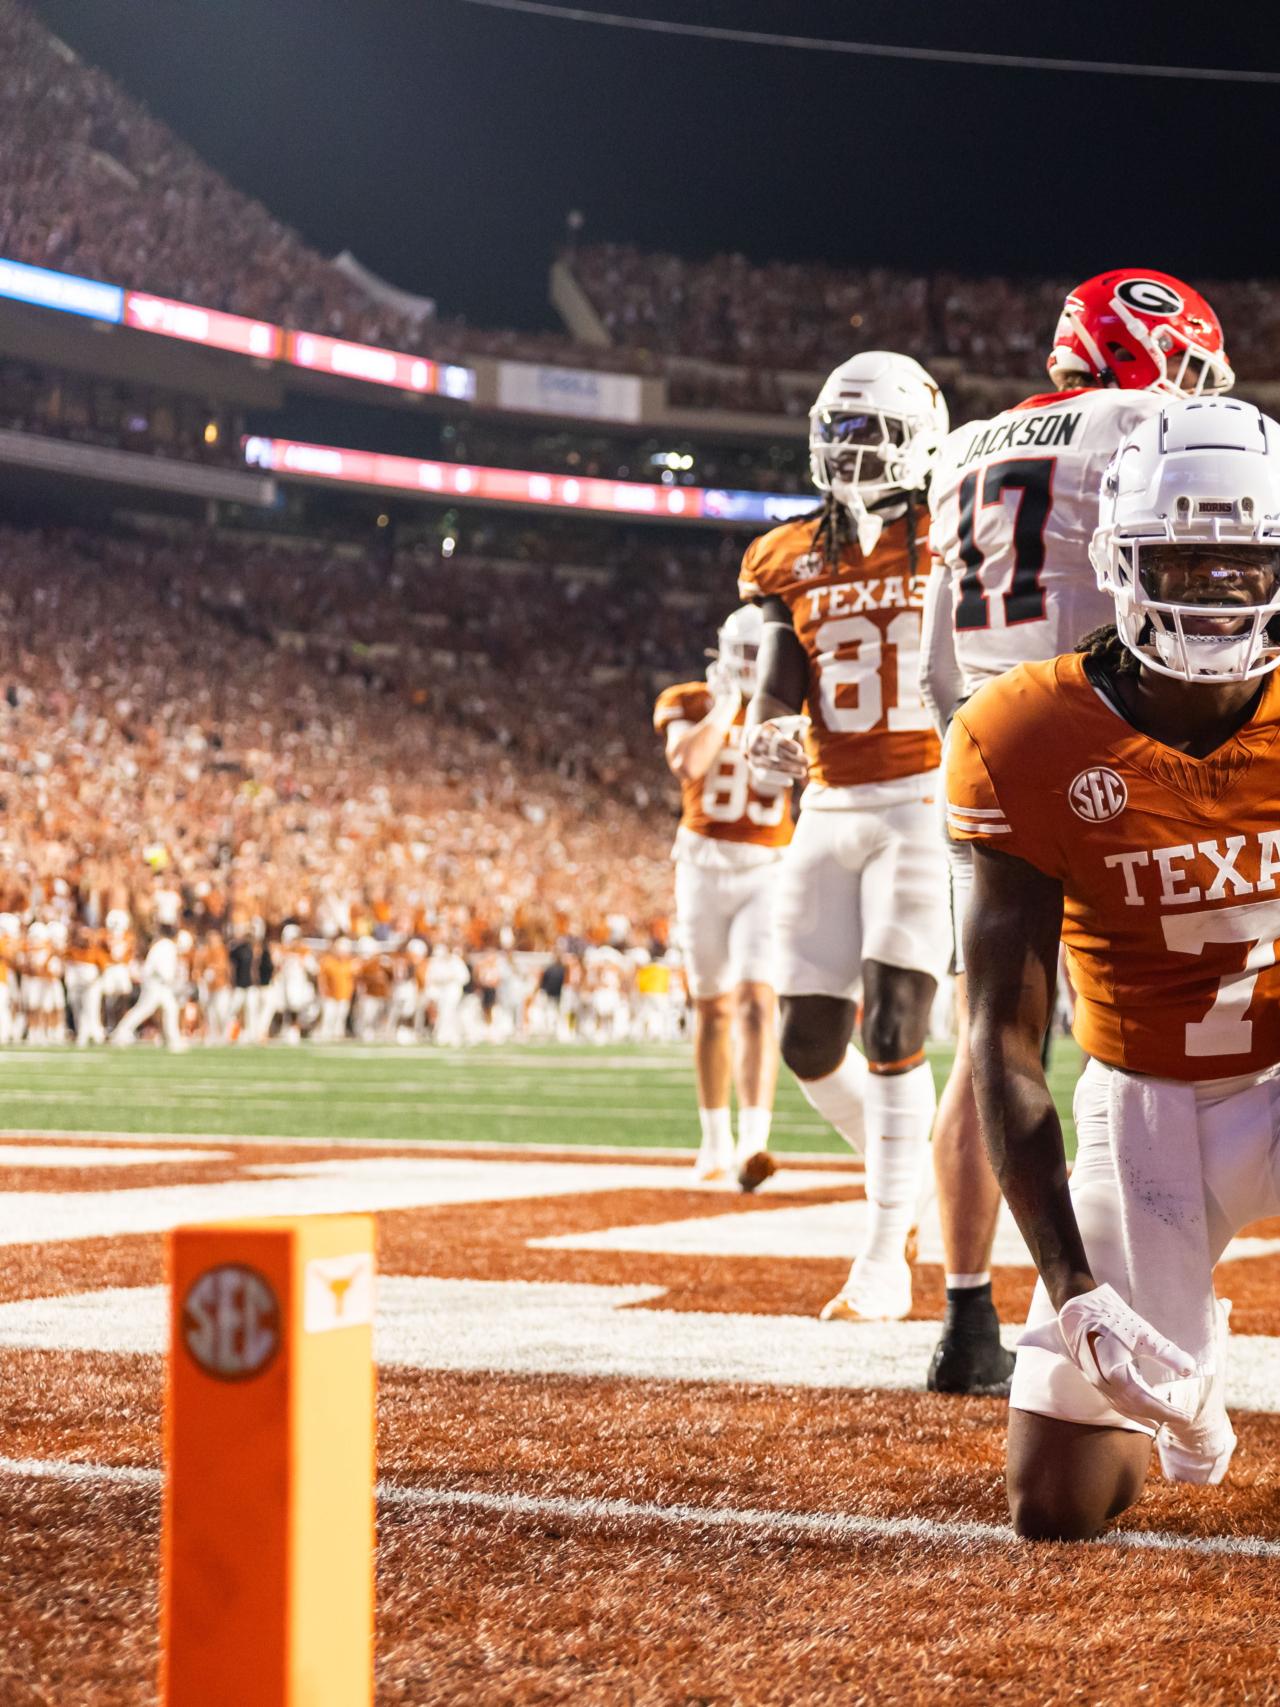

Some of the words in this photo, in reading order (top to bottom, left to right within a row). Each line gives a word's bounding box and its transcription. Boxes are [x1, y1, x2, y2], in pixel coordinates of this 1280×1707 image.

[1118, 280, 1183, 313] G
[957, 412, 1082, 468] JACKSON
[1198, 502, 1232, 512] HORNS
[955, 456, 1057, 632] 17
[806, 575, 929, 621] TEXAS
[815, 611, 936, 733] 81
[1073, 771, 1122, 819] SEC
[186, 1269, 273, 1371] SEC
